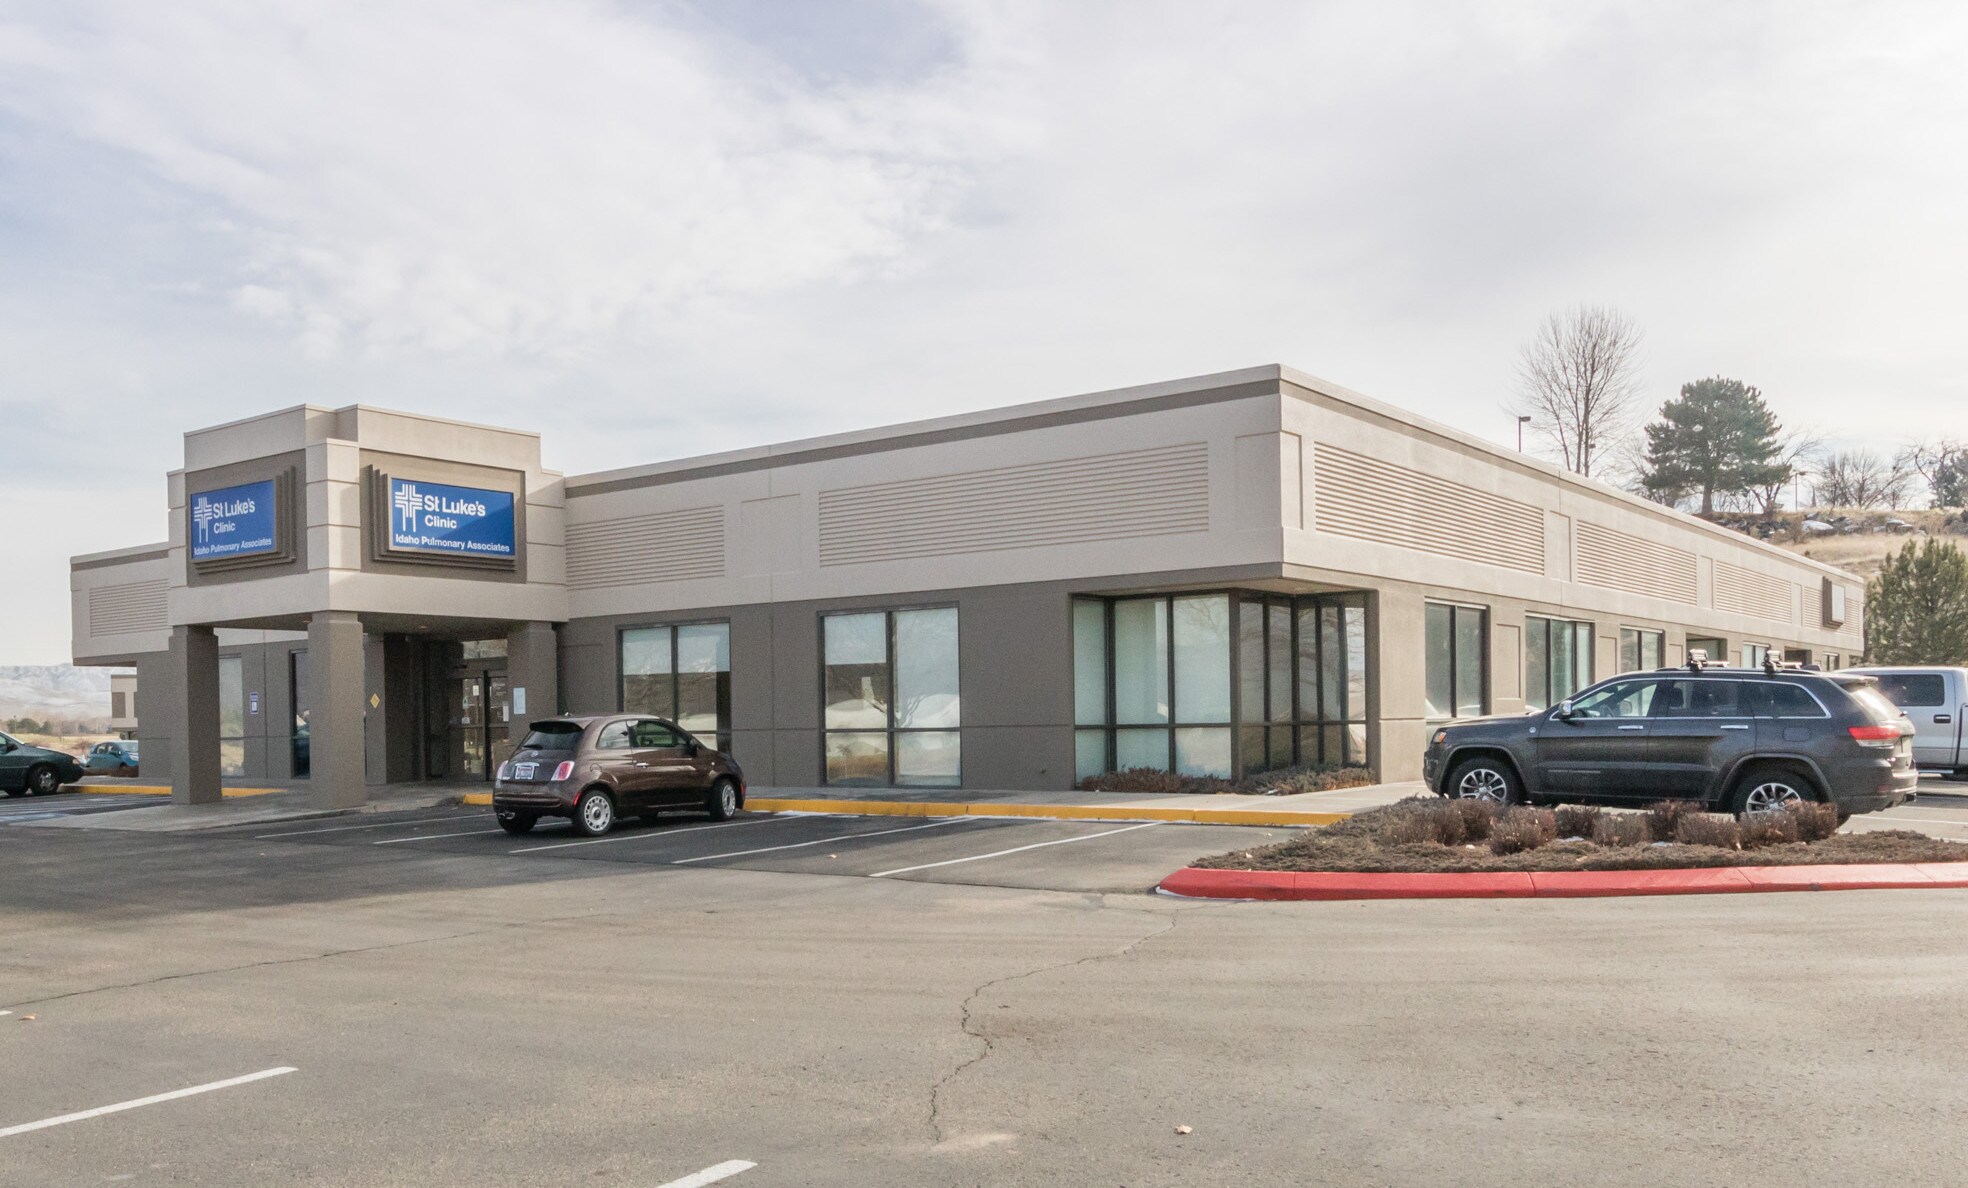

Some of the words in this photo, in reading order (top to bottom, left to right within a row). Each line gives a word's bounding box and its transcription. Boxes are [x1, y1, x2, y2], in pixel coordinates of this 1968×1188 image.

[213, 503, 223, 518] St
[224, 499, 255, 517] Luke's
[424, 495, 440, 512] St
[442, 497, 486, 517] Luke's
[213, 521, 235, 534] Clinic
[425, 515, 457, 529] Clinic
[194, 546, 209, 555] Idaho
[211, 543, 240, 552] Pulmonary
[241, 538, 272, 549] Associates
[395, 534, 420, 545] Idaho
[421, 536, 465, 550] Pulmonary
[467, 541, 510, 552] Associates
